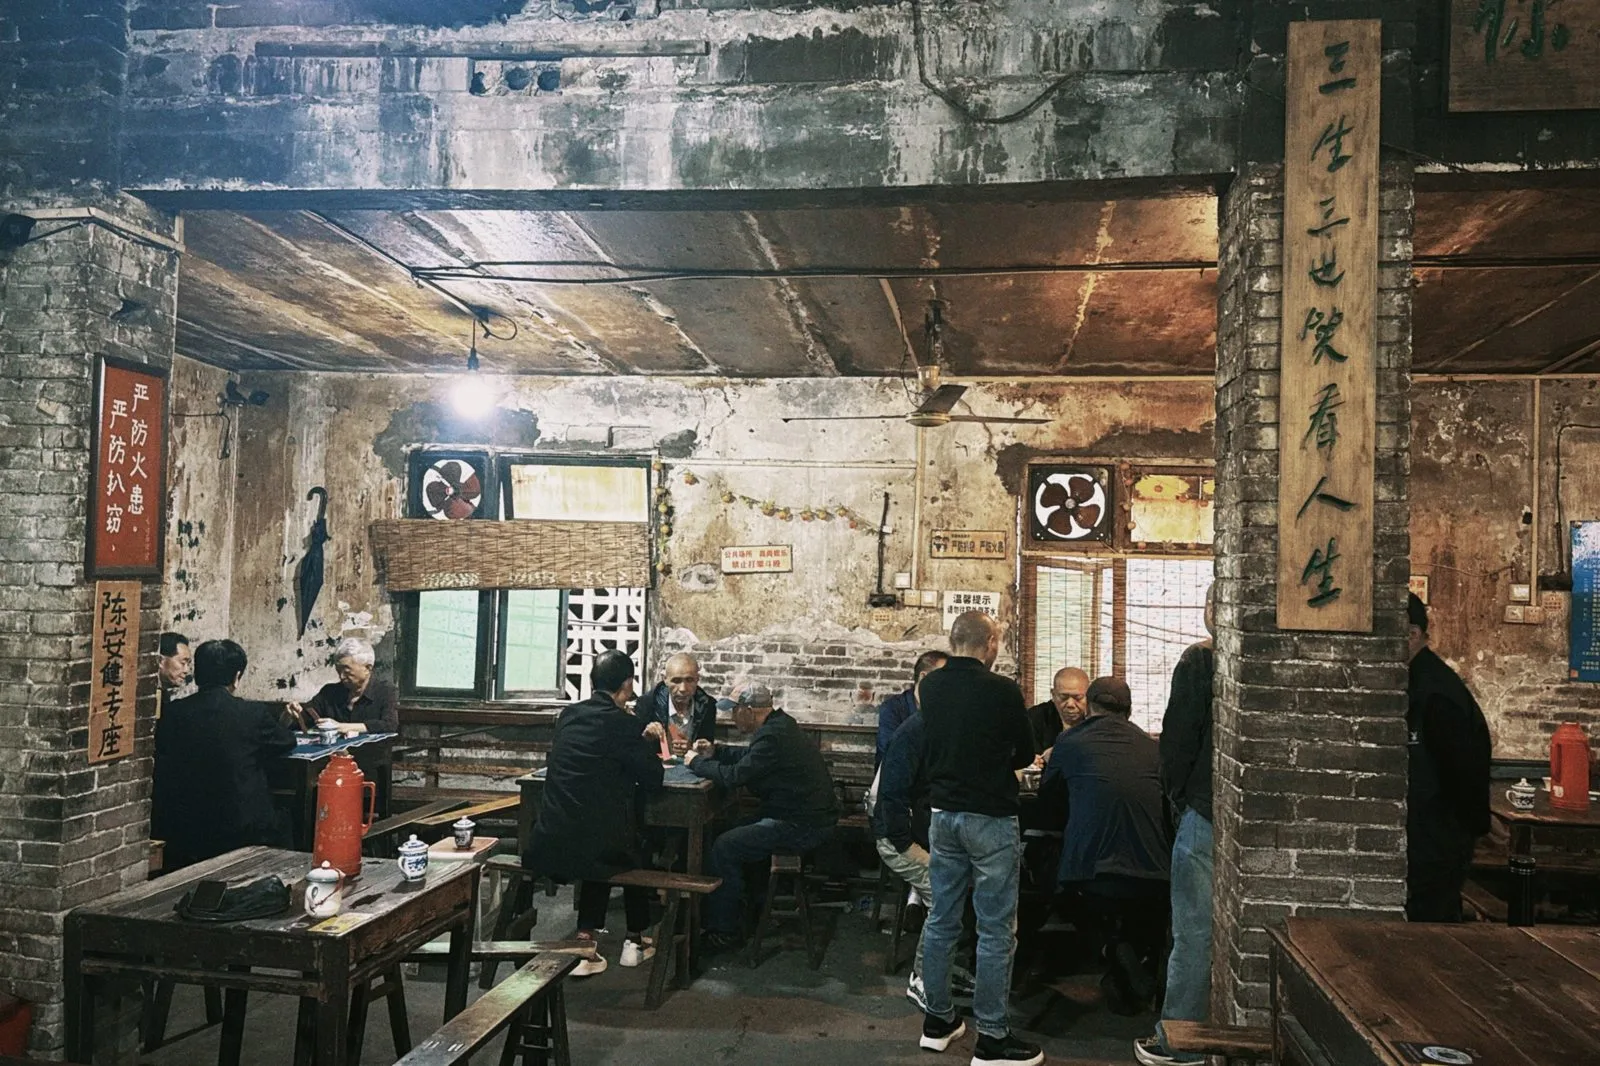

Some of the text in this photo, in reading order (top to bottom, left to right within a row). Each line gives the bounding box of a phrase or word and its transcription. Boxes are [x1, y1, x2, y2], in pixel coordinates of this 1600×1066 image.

[1296, 41, 1359, 608] 三生三世笑看人生
[98, 591, 128, 757] 陈安健专座
[953, 594, 991, 605] 温馨提示
